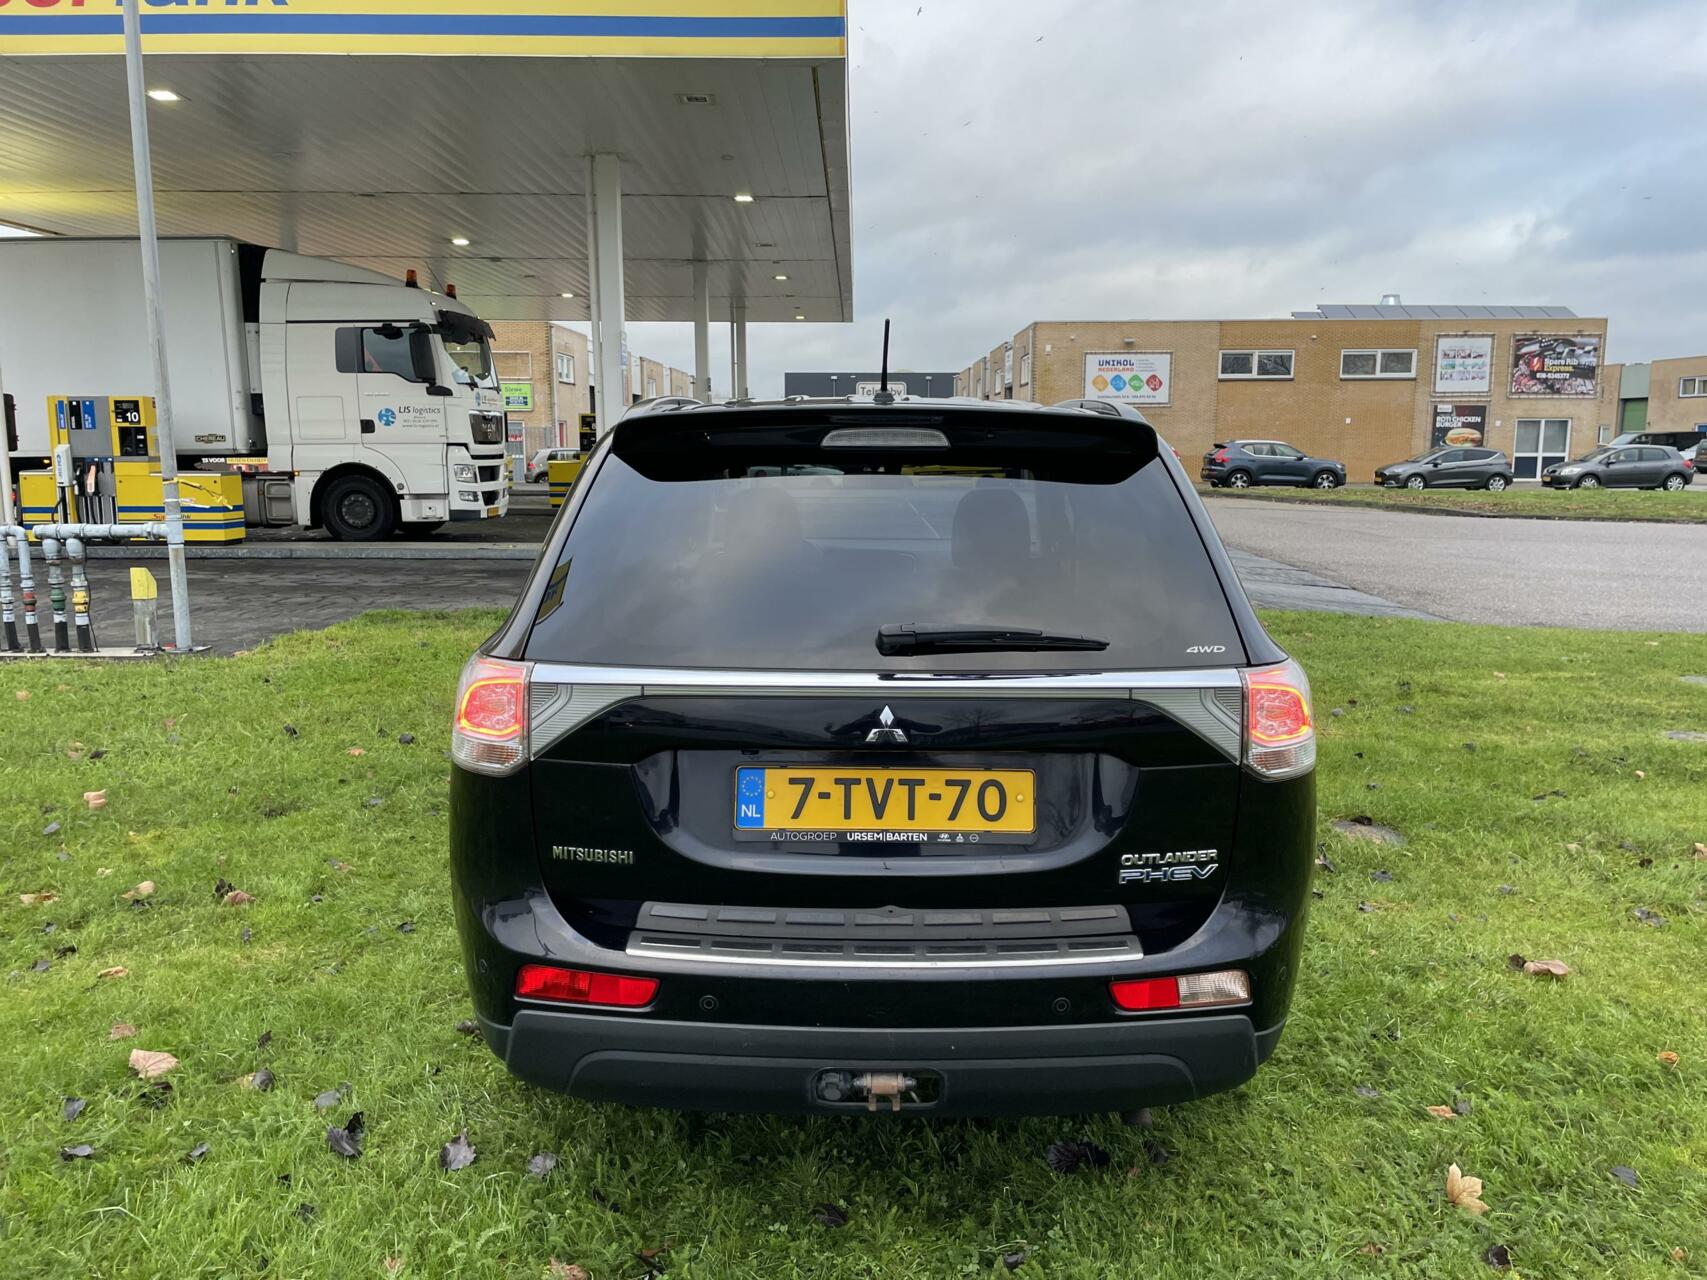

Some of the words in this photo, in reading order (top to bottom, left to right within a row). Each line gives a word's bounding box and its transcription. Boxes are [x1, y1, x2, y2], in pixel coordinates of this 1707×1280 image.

[1098, 359, 1134, 367] UNIKOL
[126, 411, 139, 422] 10
[398, 405, 411, 414] LIS
[412, 406, 441, 416] logistics
[1185, 645, 1226, 654] 4WD
[788, 777, 1008, 822] 7-TVT-70
[741, 804, 761, 818] NL
[770, 831, 837, 842] AUTOGROEP
[552, 845, 634, 865] MITSUBISHI
[1121, 849, 1218, 866] OUTLANDER
[1119, 863, 1219, 884] PHEV
